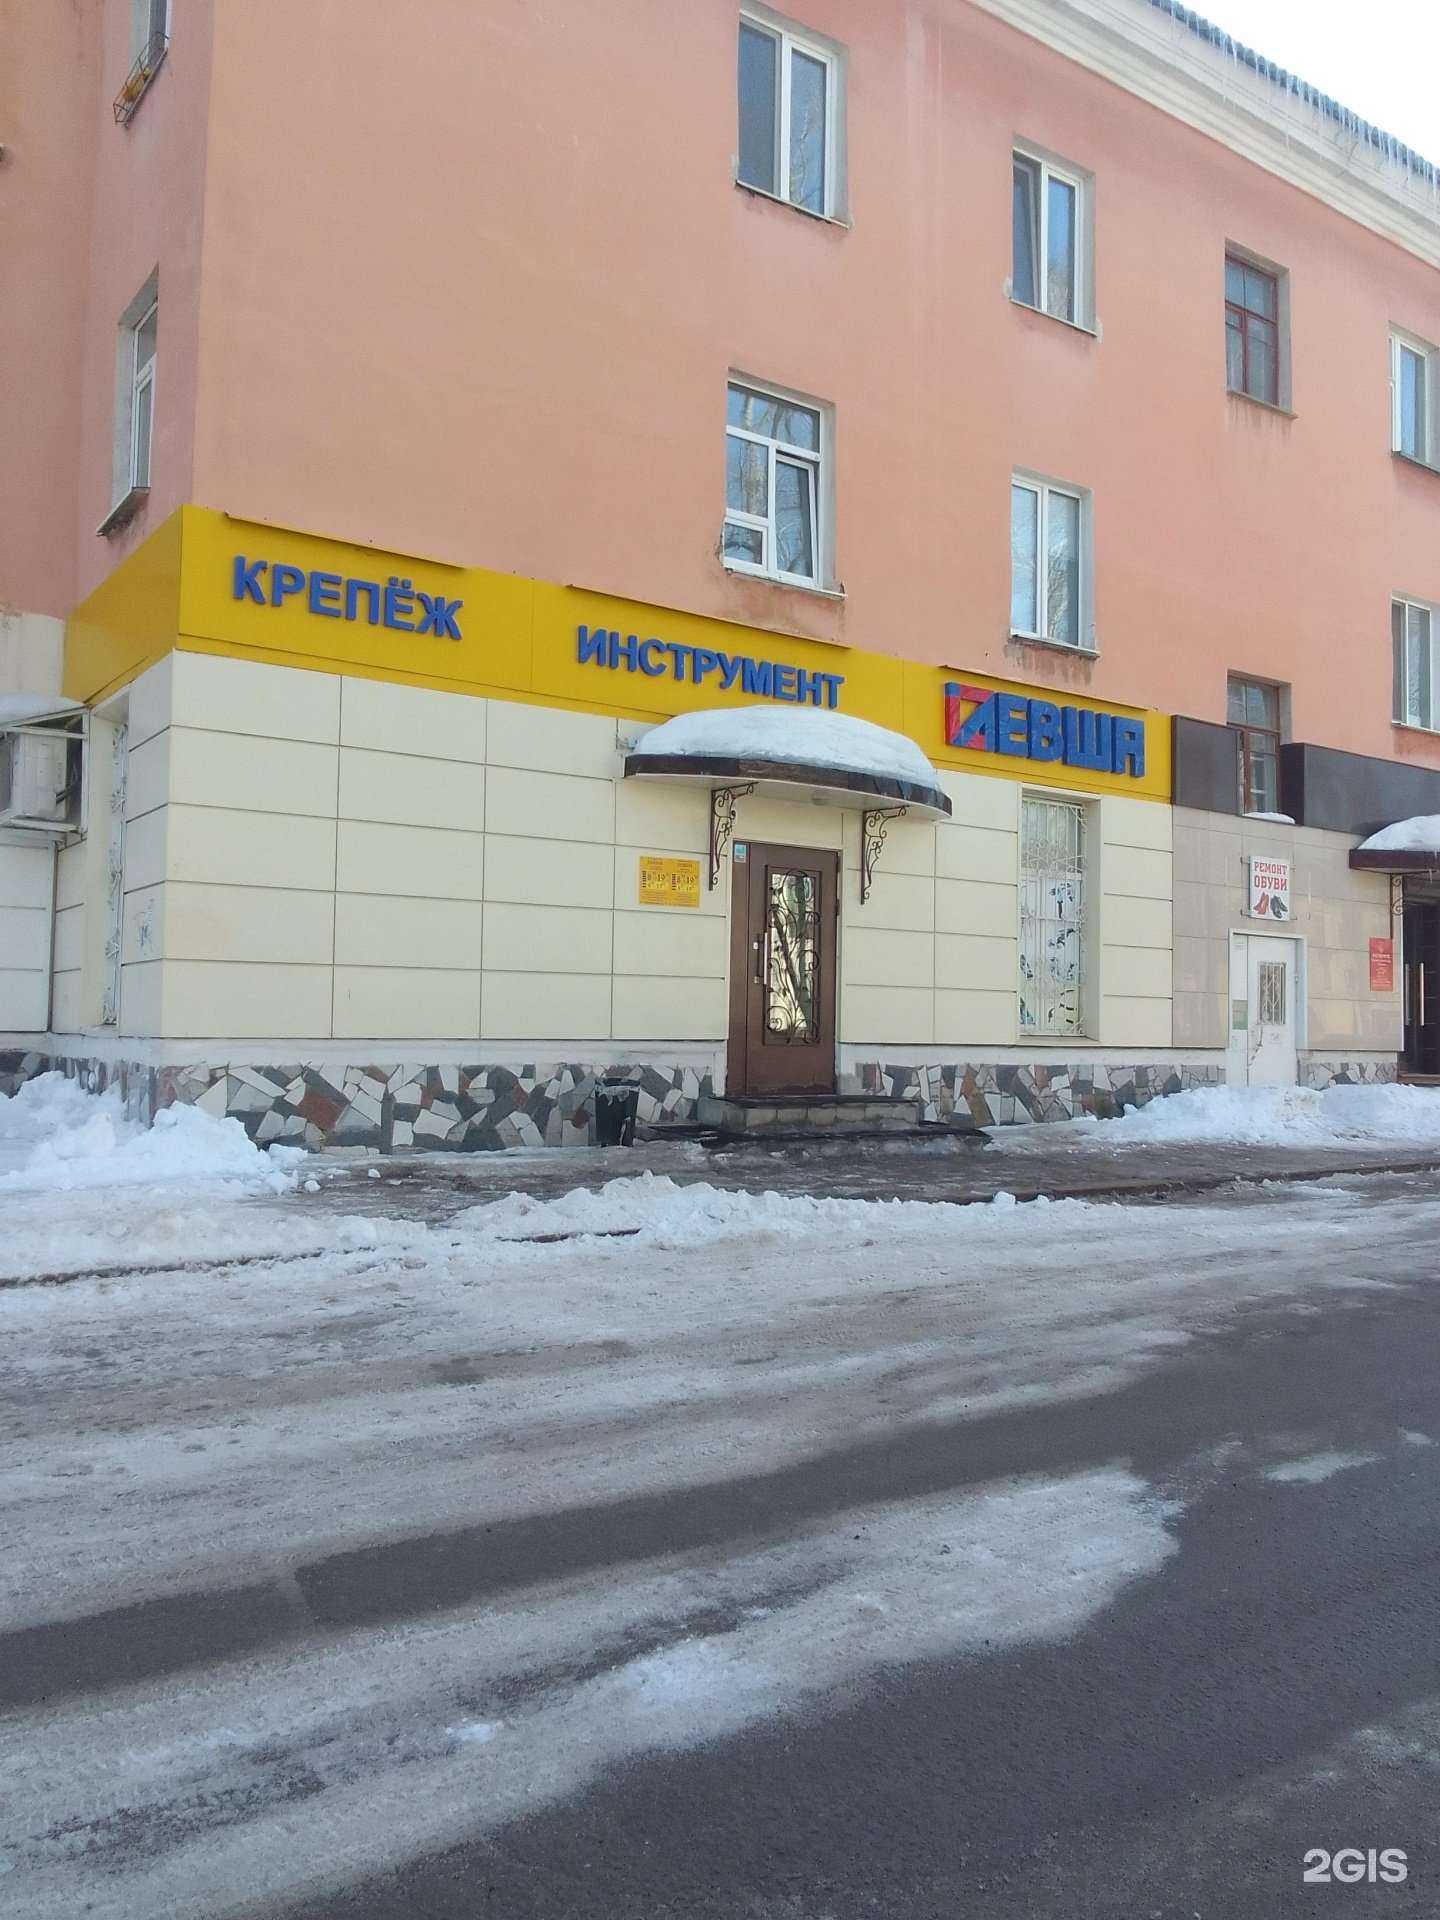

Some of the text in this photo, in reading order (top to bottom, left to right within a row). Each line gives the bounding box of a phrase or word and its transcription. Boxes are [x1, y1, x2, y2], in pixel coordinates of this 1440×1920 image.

[233, 555, 464, 640] КРЕПЁЖ
[577, 624, 845, 709] ИНСТРУМЕНТ
[944, 681, 1145, 777] ЛЕВША
[1254, 861, 1288, 875] РЕМОНТ
[1254, 875, 1288, 891] ОБУВИ
